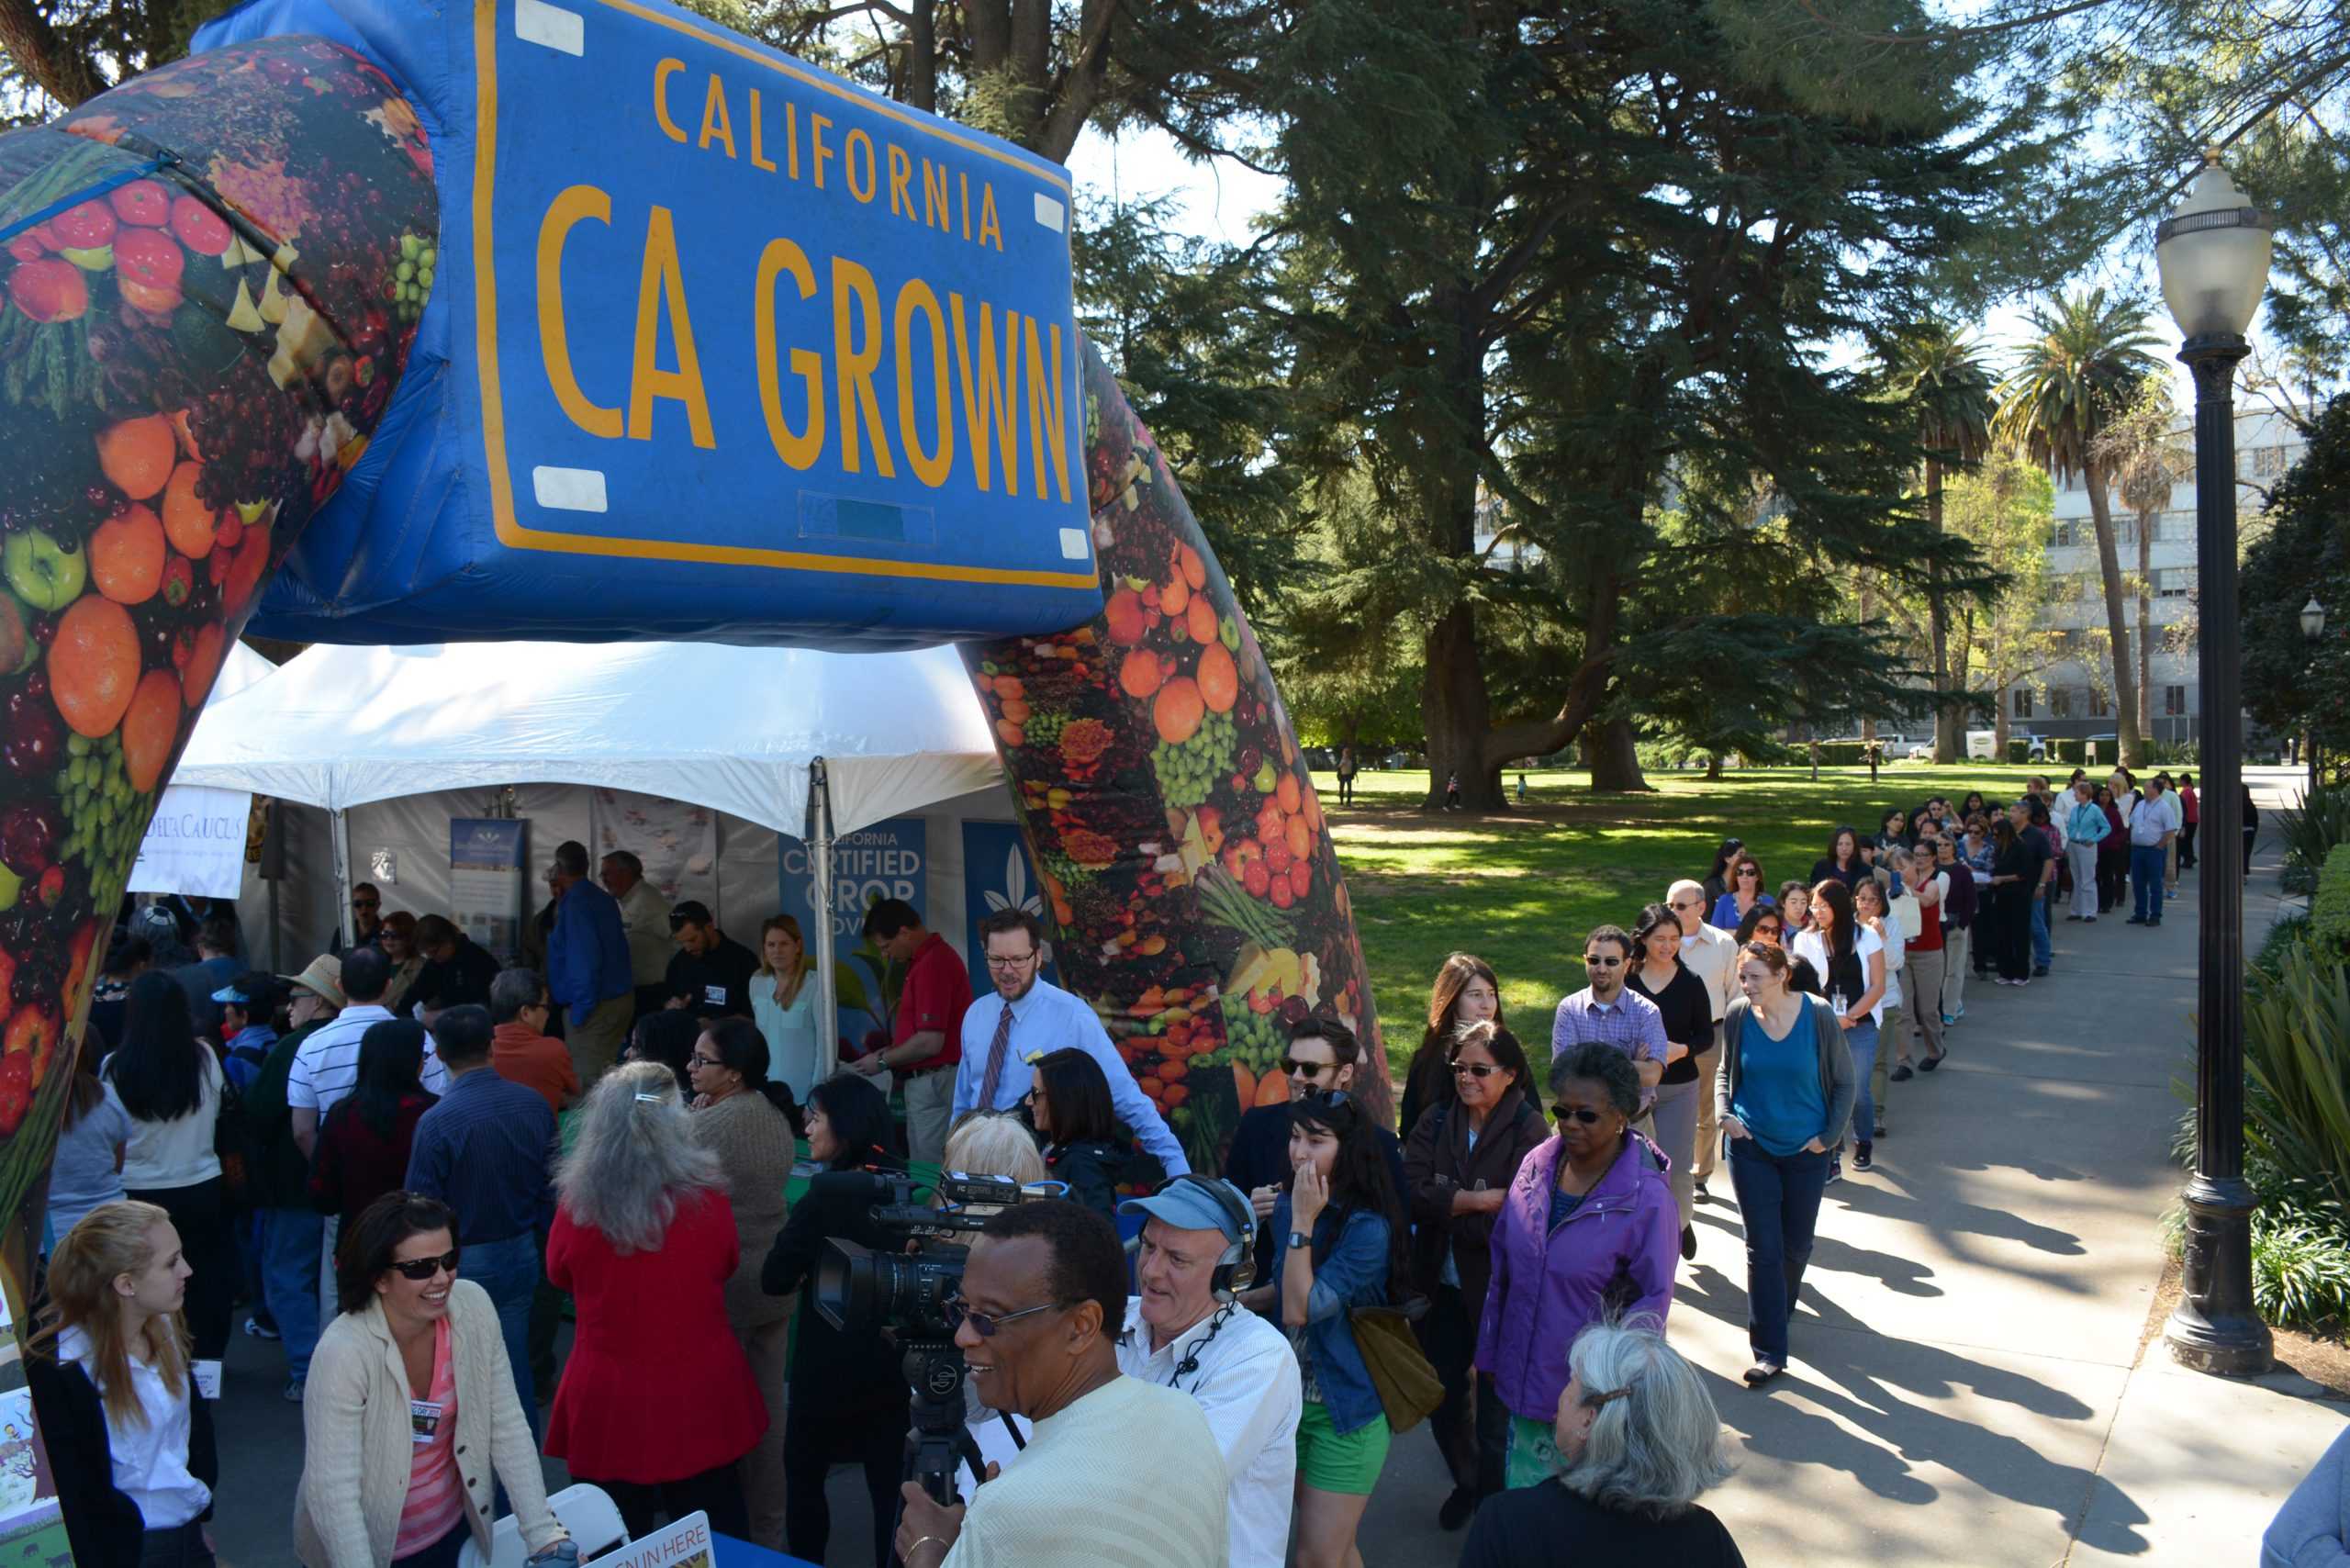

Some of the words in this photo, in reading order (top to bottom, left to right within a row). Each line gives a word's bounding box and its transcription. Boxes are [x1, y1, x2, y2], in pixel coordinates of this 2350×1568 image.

[653, 57, 1005, 252] CALIFORNIA
[536, 185, 716, 450] CA
[755, 237, 1072, 504] GROWN
[663, 1524, 707, 1561] HERE
